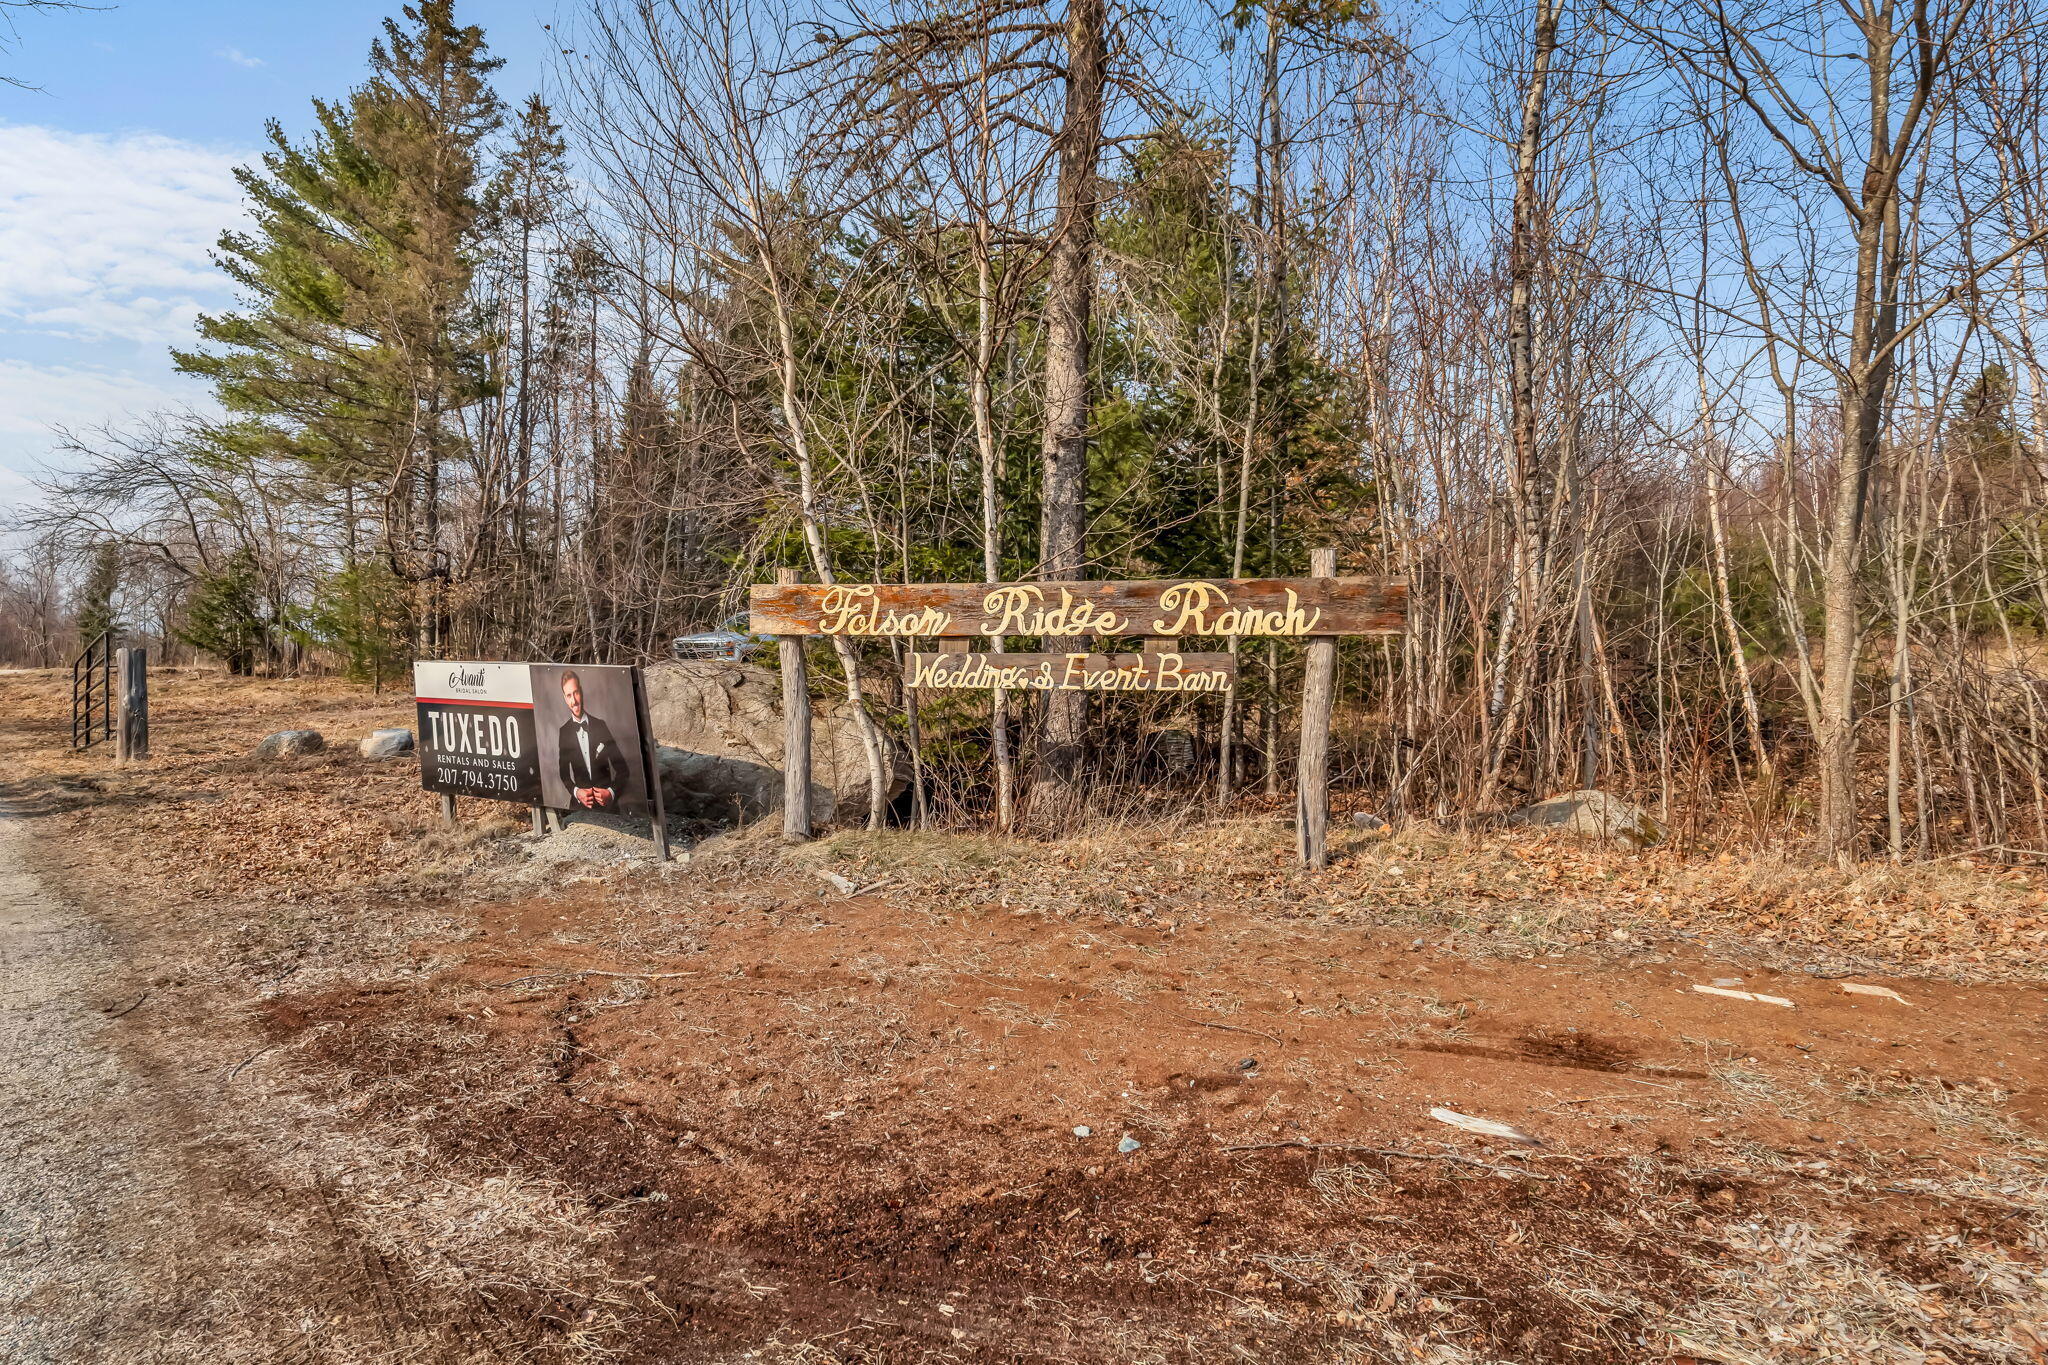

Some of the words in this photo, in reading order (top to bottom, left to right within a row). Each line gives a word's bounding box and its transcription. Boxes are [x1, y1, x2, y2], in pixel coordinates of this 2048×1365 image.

[980, 584, 1129, 636] Ridge
[1152, 581, 1320, 636] Ranch
[448, 668, 486, 688] Avanti
[907, 652, 1025, 689] Wedding
[1058, 653, 1150, 690] Event
[1156, 652, 1232, 691] Barn
[428, 711, 521, 759] TUXEDO
[437, 754, 470, 766] RENTALS
[472, 758, 490, 768] AND
[492, 761, 516, 771] SALES
[437, 767, 518, 792] 207.794.3750
